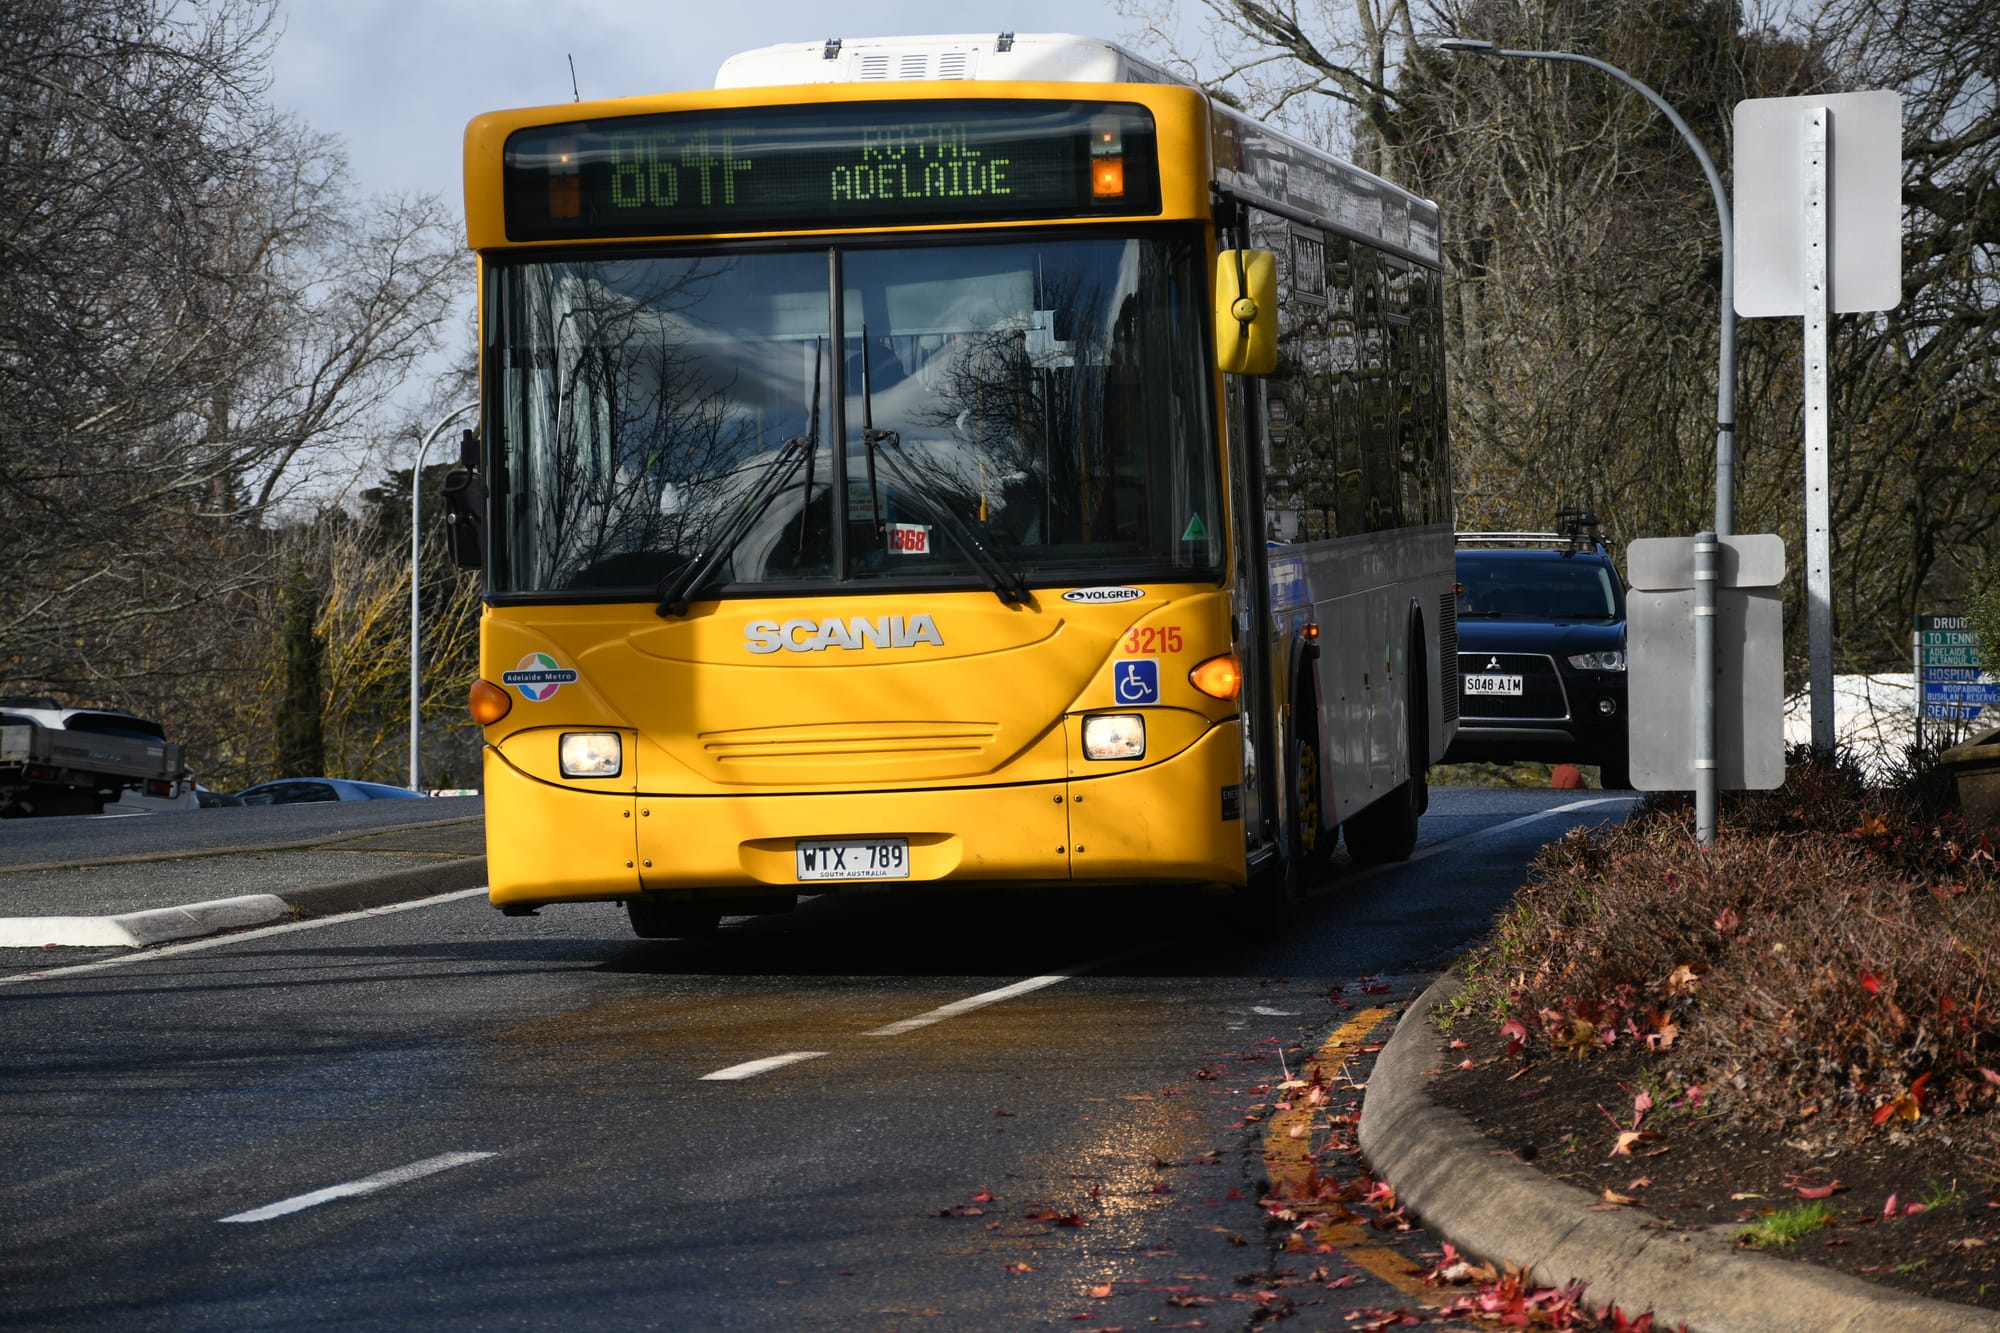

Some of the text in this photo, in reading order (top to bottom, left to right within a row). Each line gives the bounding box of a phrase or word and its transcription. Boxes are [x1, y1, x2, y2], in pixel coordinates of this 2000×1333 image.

[832, 159, 1010, 200] ADELAIDE
[889, 529, 926, 552] 1368
[1085, 590, 1138, 600] VOLGREN
[744, 614, 944, 654] SCANIA
[1929, 633, 1941, 644] TO
[1124, 626, 1183, 655] 3215
[1929, 647, 1966, 657] ADELAIDE
[1929, 656, 1968, 665] PETANQUE
[507, 672, 572, 682] Adelaide Metro
[1929, 668, 1976, 680] HOSPITAL
[1927, 705, 1971, 718] DENTIST
